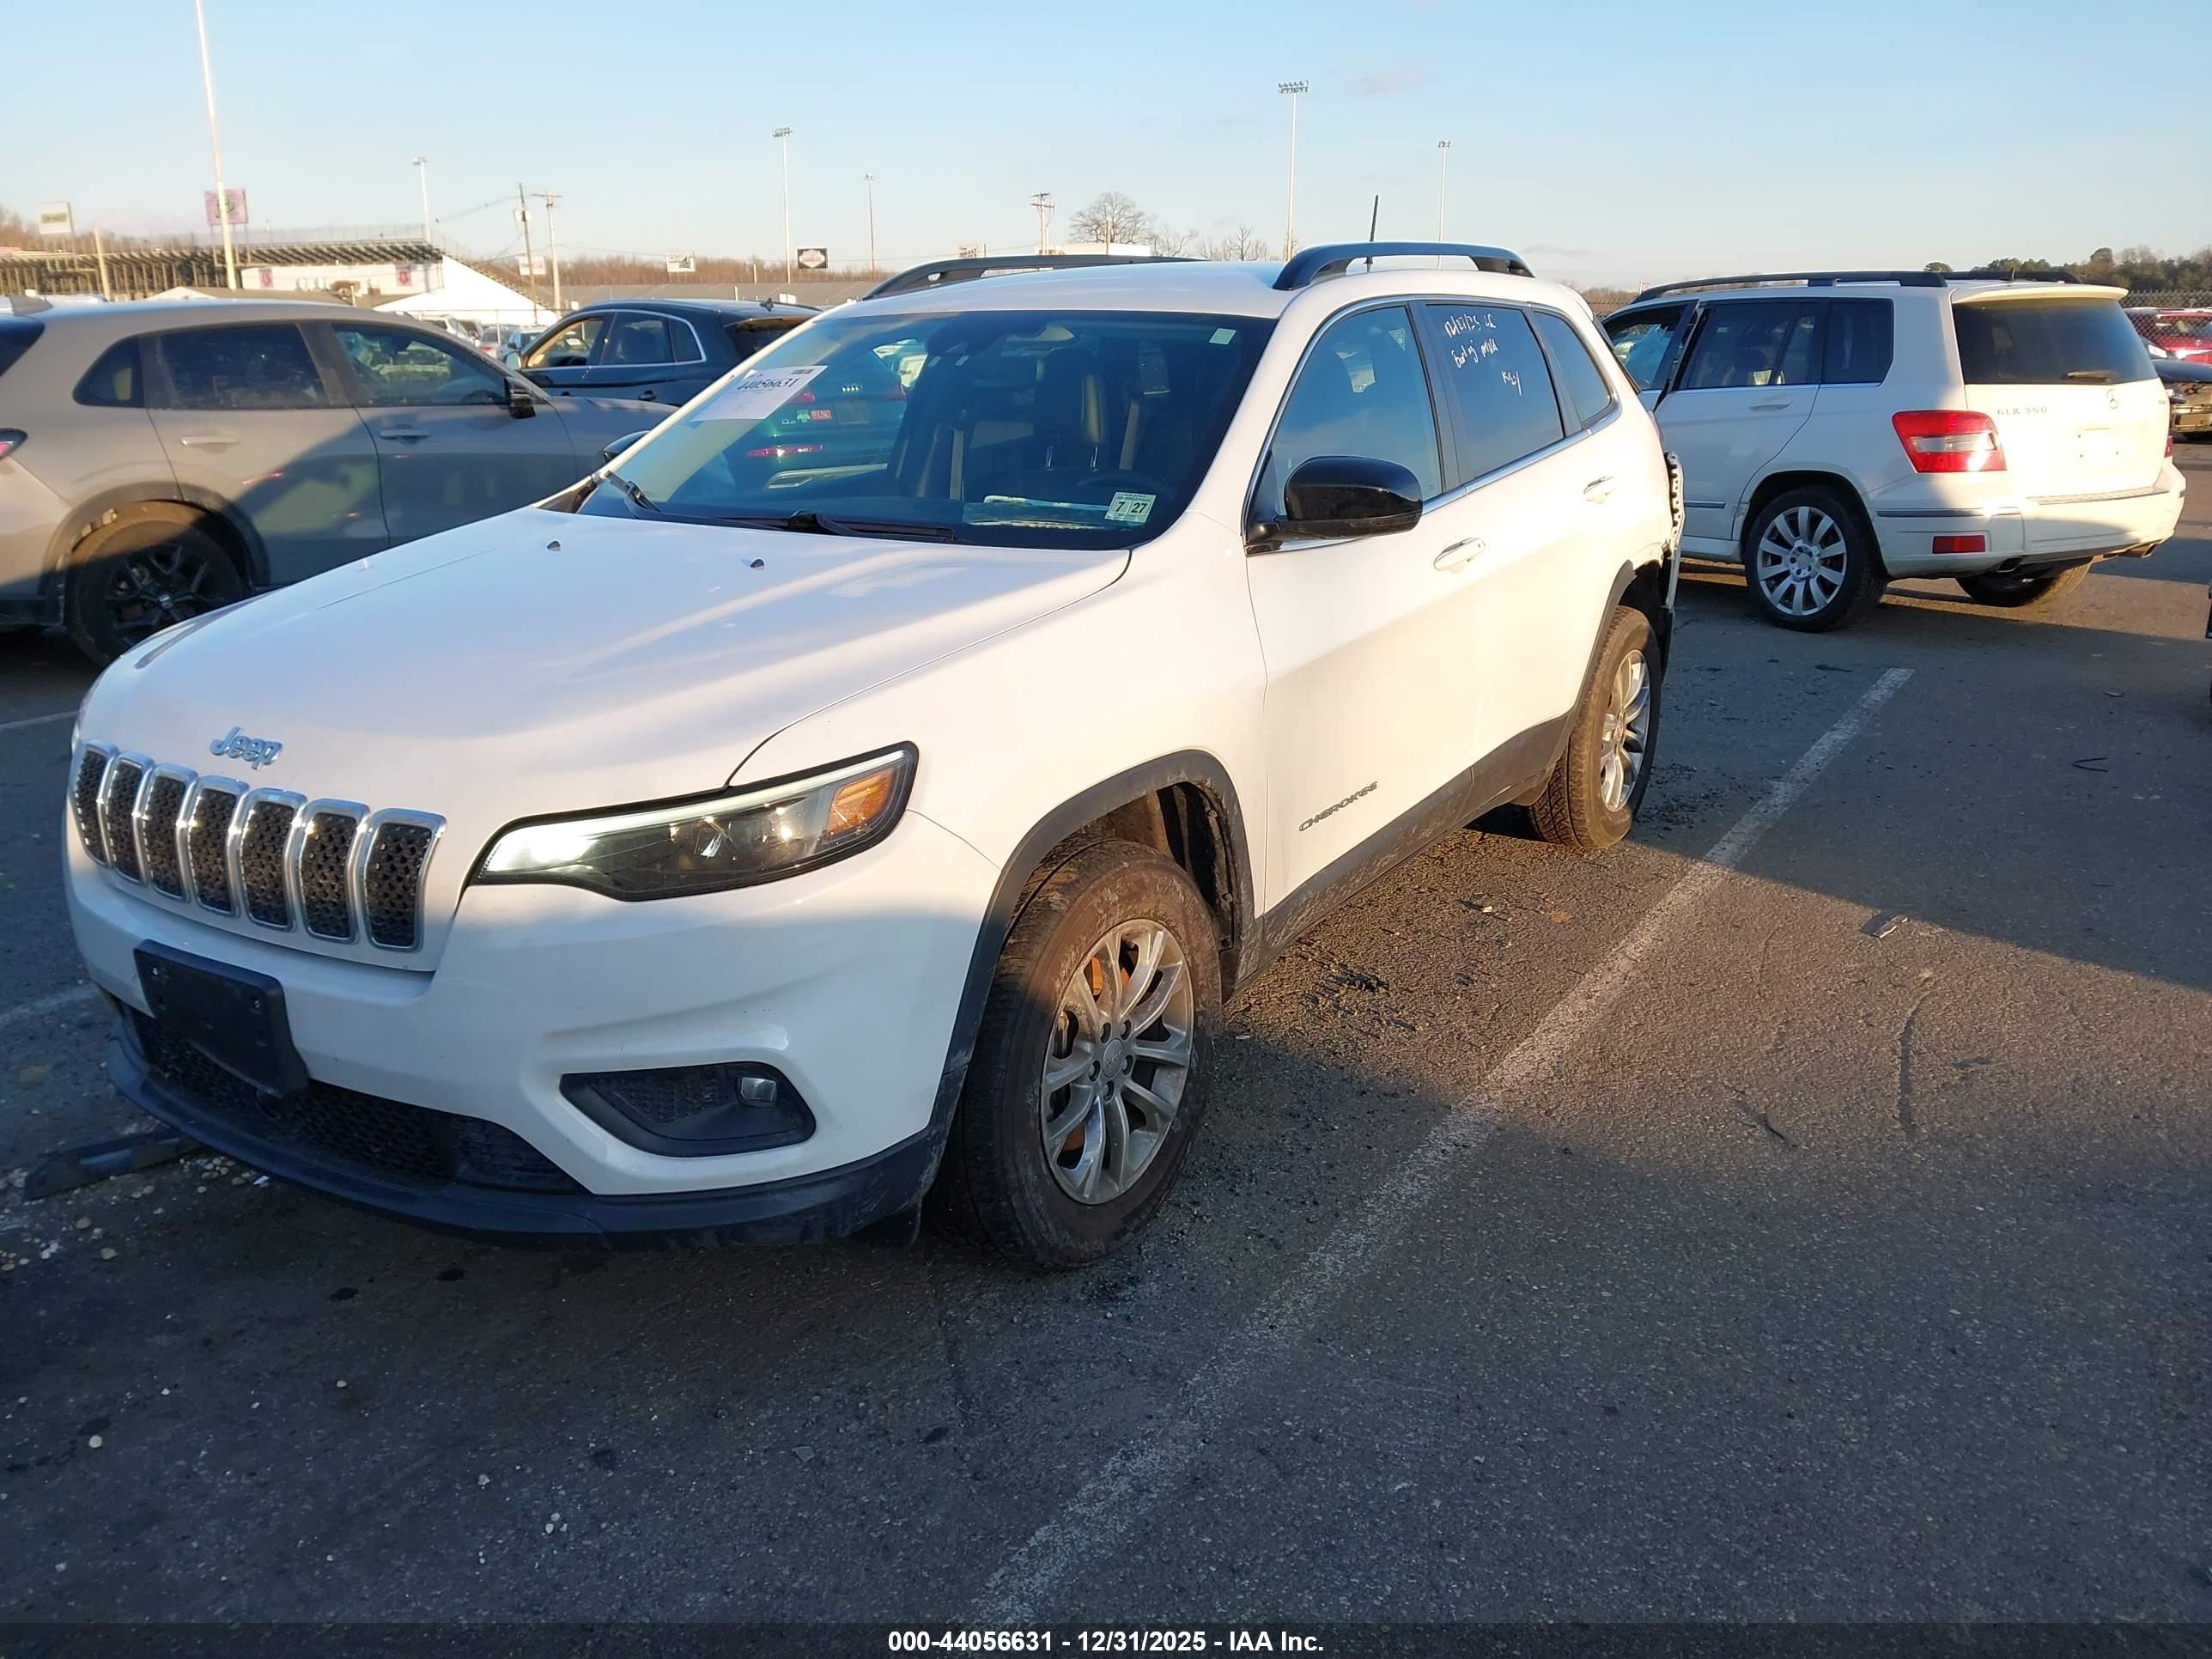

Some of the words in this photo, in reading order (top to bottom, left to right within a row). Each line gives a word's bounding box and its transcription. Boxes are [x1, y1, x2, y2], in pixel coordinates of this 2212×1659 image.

[1116, 501, 1126, 512] 7
[1131, 502, 1148, 514] 27
[210, 726, 282, 770] Jeep
[1298, 781, 1378, 831] CHEROKEE
